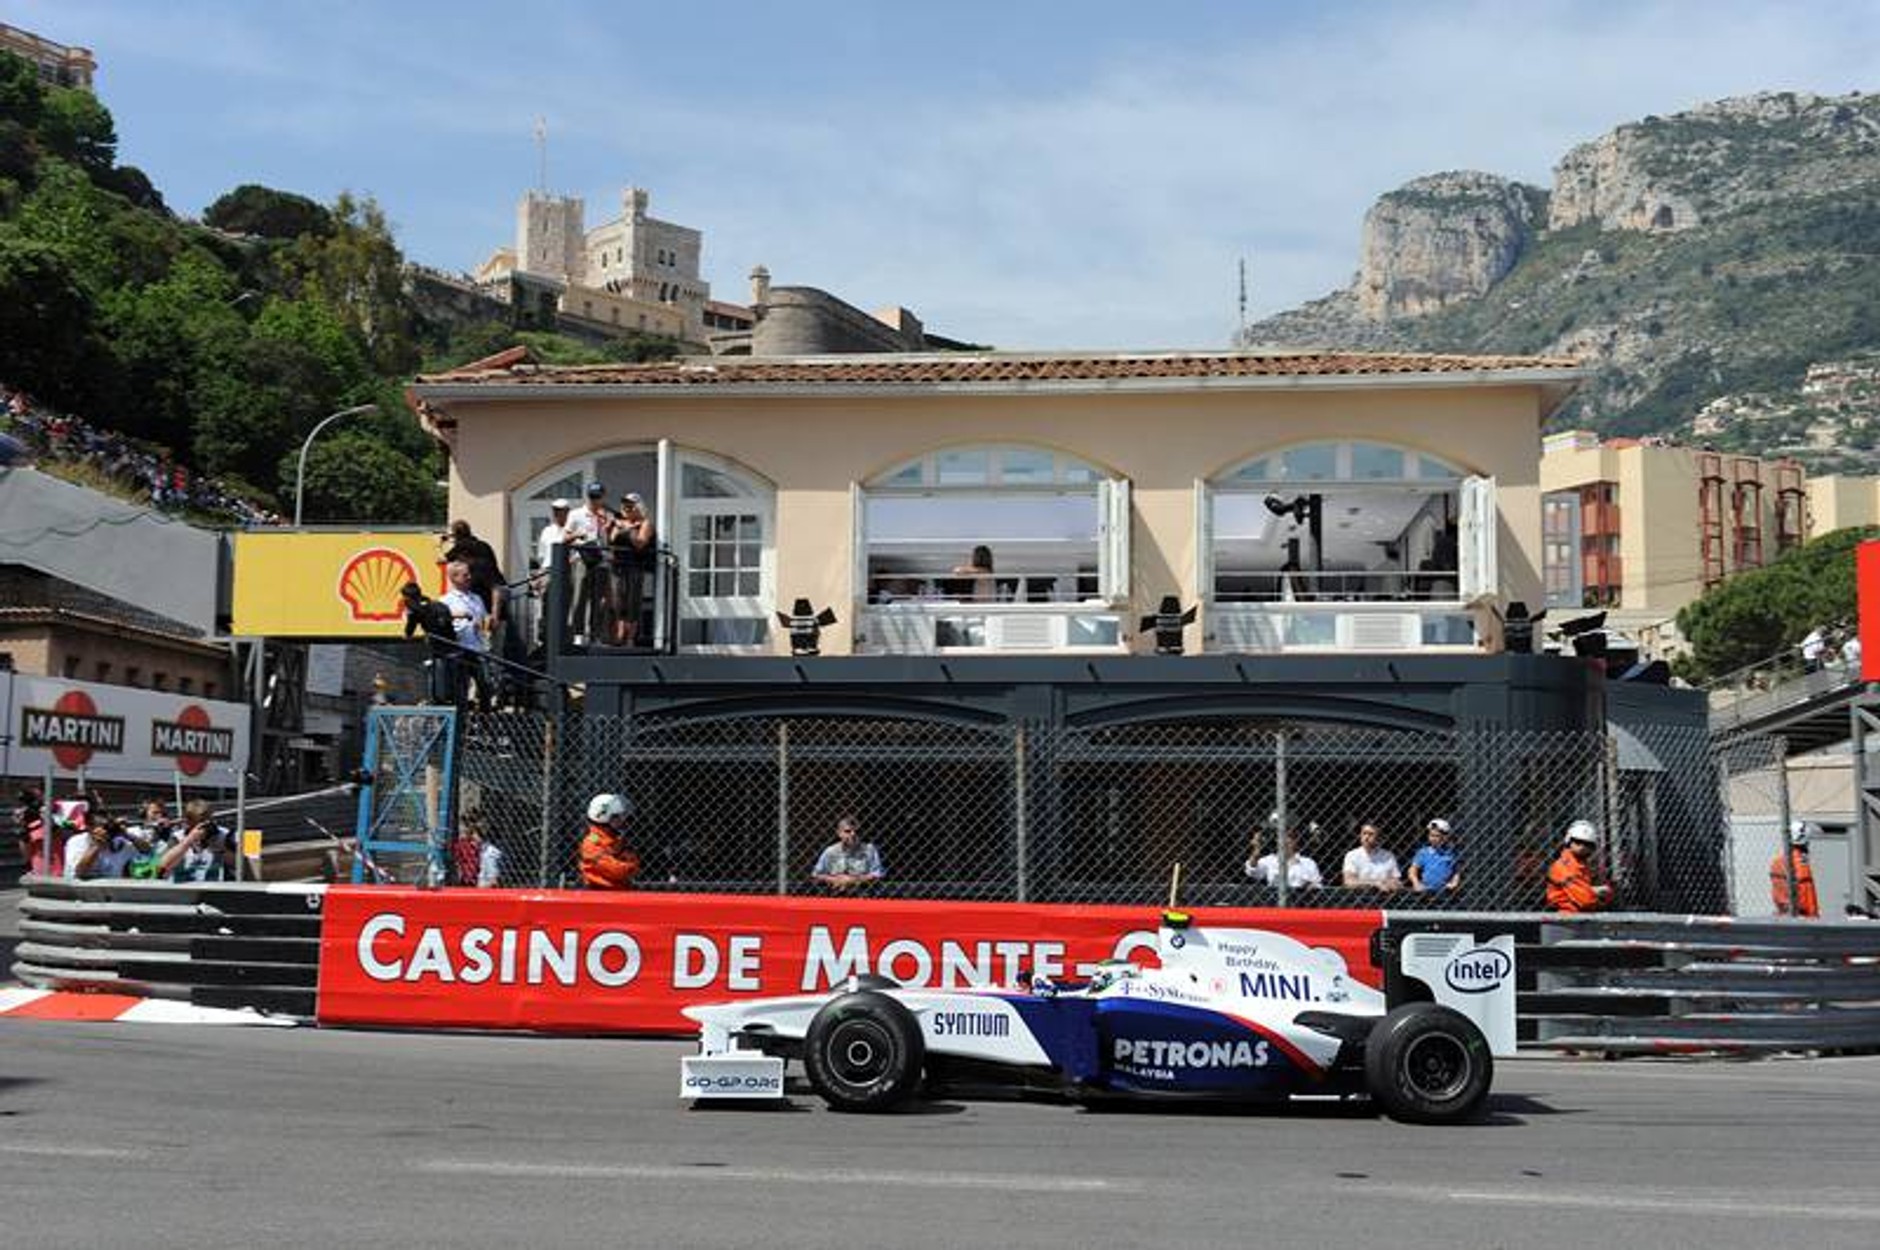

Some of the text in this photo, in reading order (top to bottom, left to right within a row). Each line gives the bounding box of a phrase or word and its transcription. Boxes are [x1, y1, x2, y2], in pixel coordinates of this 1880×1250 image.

[26, 713, 120, 746] MARTINI
[154, 726, 230, 754] MARTINI
[357, 913, 641, 987] CASINO
[673, 933, 762, 990] DE
[1218, 942, 1258, 957] Happy
[1453, 958, 1500, 980] intel
[1239, 971, 1321, 1003] MINI.
[934, 1012, 1010, 1037] SYNTIUM
[1114, 1038, 1269, 1068] PETRONAS
